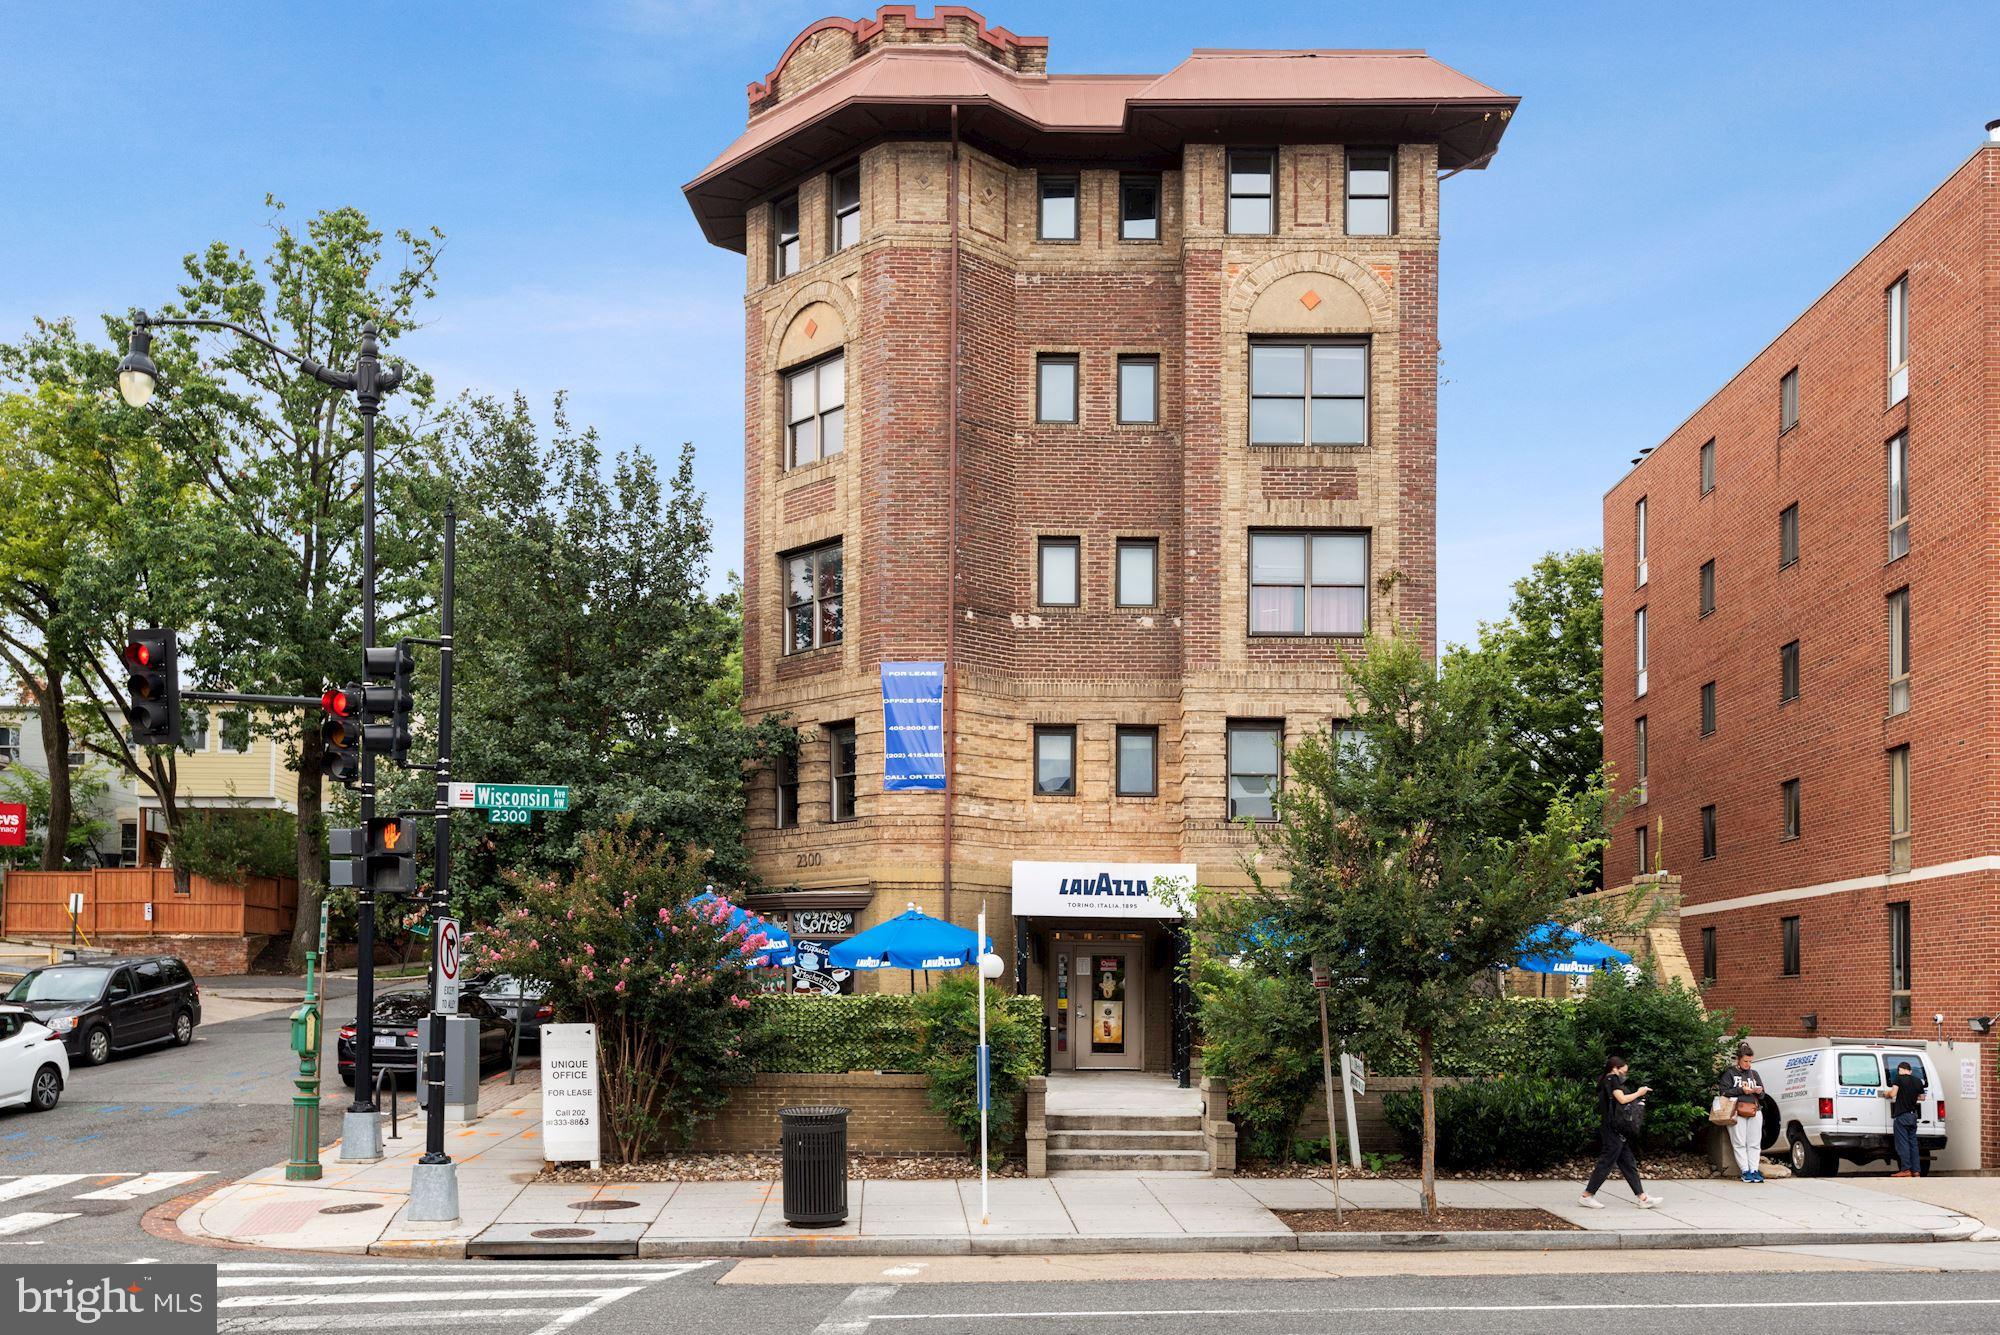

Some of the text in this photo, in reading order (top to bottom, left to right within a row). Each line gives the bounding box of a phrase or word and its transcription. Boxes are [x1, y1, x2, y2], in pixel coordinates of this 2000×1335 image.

[477, 787, 566, 807] Wisconsin Ave
[553, 799, 565, 808] NW
[492, 810, 528, 822] 2300
[797, 852, 821, 868] 2300
[1059, 872, 1149, 897] LAVAZZA
[800, 911, 847, 933] Coffee
[922, 956, 962, 968] LAVAZZA
[551, 1060, 589, 1069] UNIQUE
[552, 1071, 587, 1079] OFFICE
[548, 1089, 565, 1097] FOR
[555, 1109, 571, 1117] Call
[553, 1118, 589, 1126] 333-8863
